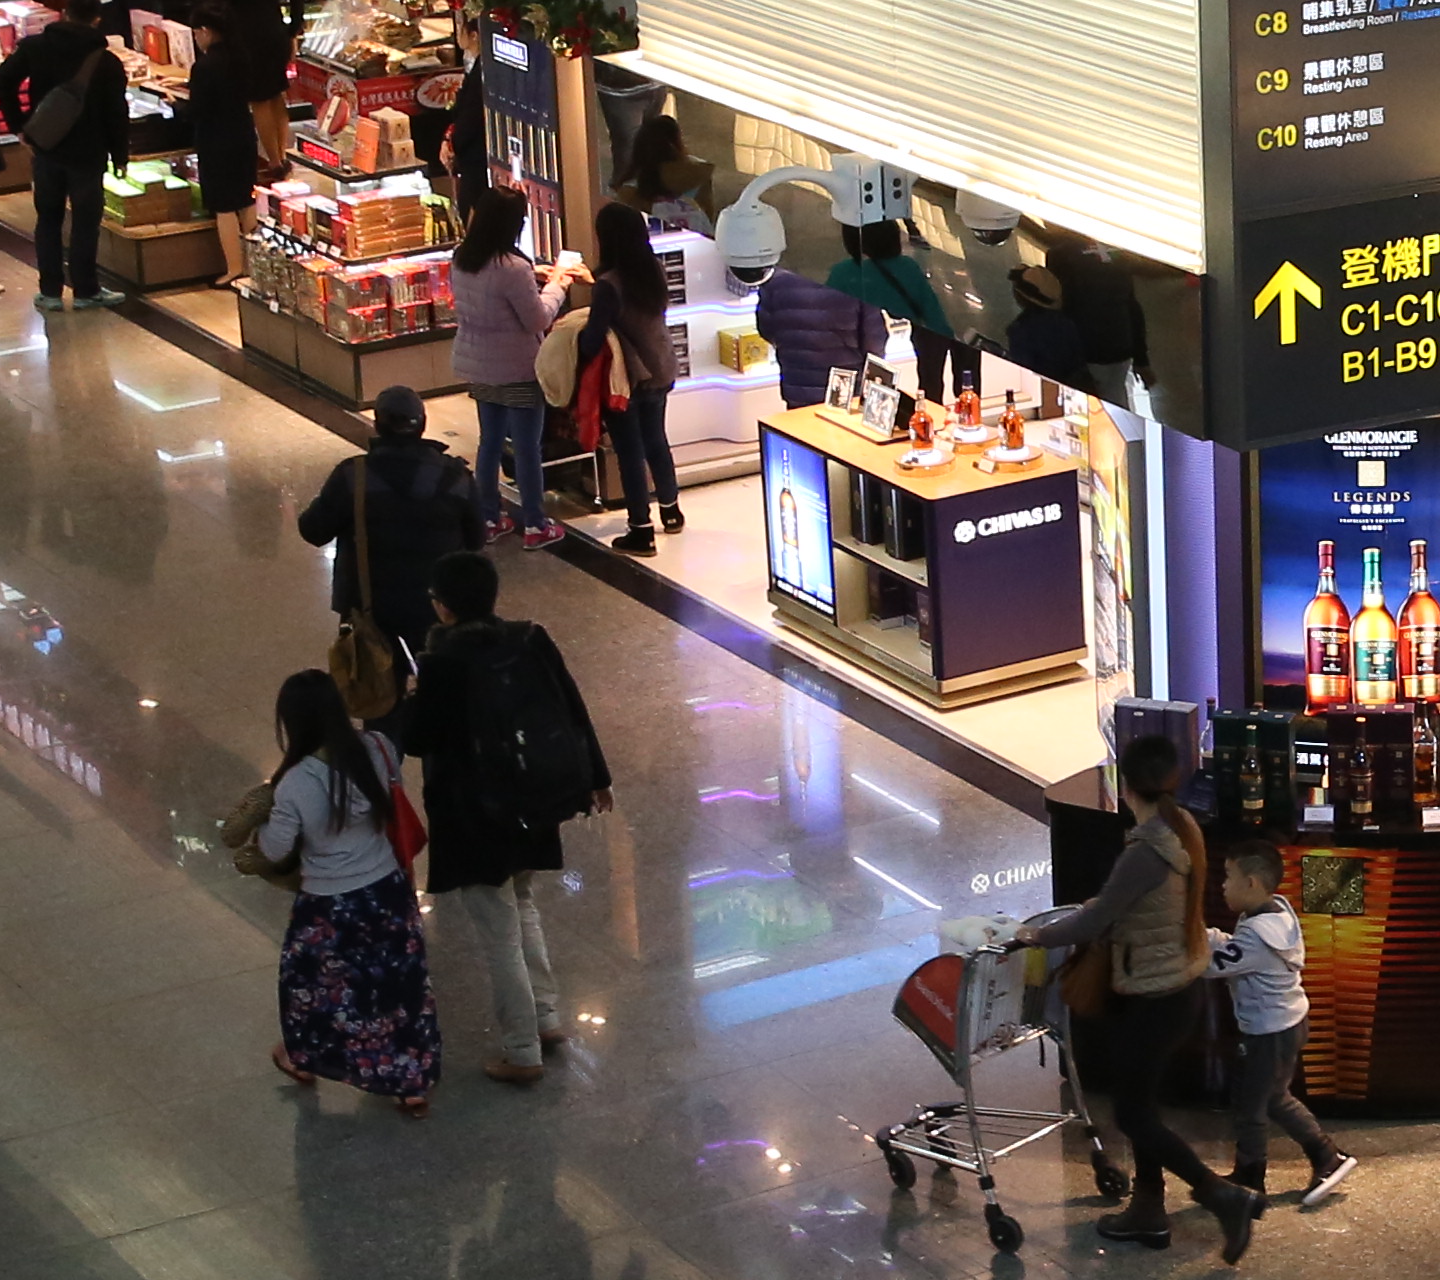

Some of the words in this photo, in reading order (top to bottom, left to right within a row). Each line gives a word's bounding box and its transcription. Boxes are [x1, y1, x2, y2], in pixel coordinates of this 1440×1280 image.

[1255, 12, 1288, 36] C8
[1303, 19, 1365, 35] Breastfeeding
[1367, 14, 1393, 26] Room
[1303, 53, 1384, 81] 景觀休憩區
[1256, 69, 1289, 94] C9
[1303, 81, 1342, 95] Resting
[1344, 77, 1368, 90] Area
[1304, 107, 1384, 136] 景觀休憩區
[1257, 125, 1297, 151] C10
[1344, 131, 1369, 144] Area
[1342, 337, 1436, 384] B1-B9
[1333, 492, 1411, 502] LEGENDS
[978, 507, 1043, 536] CHIVAS
[1043, 504, 1062, 522] 18
[1213, 943, 1243, 970] 2
